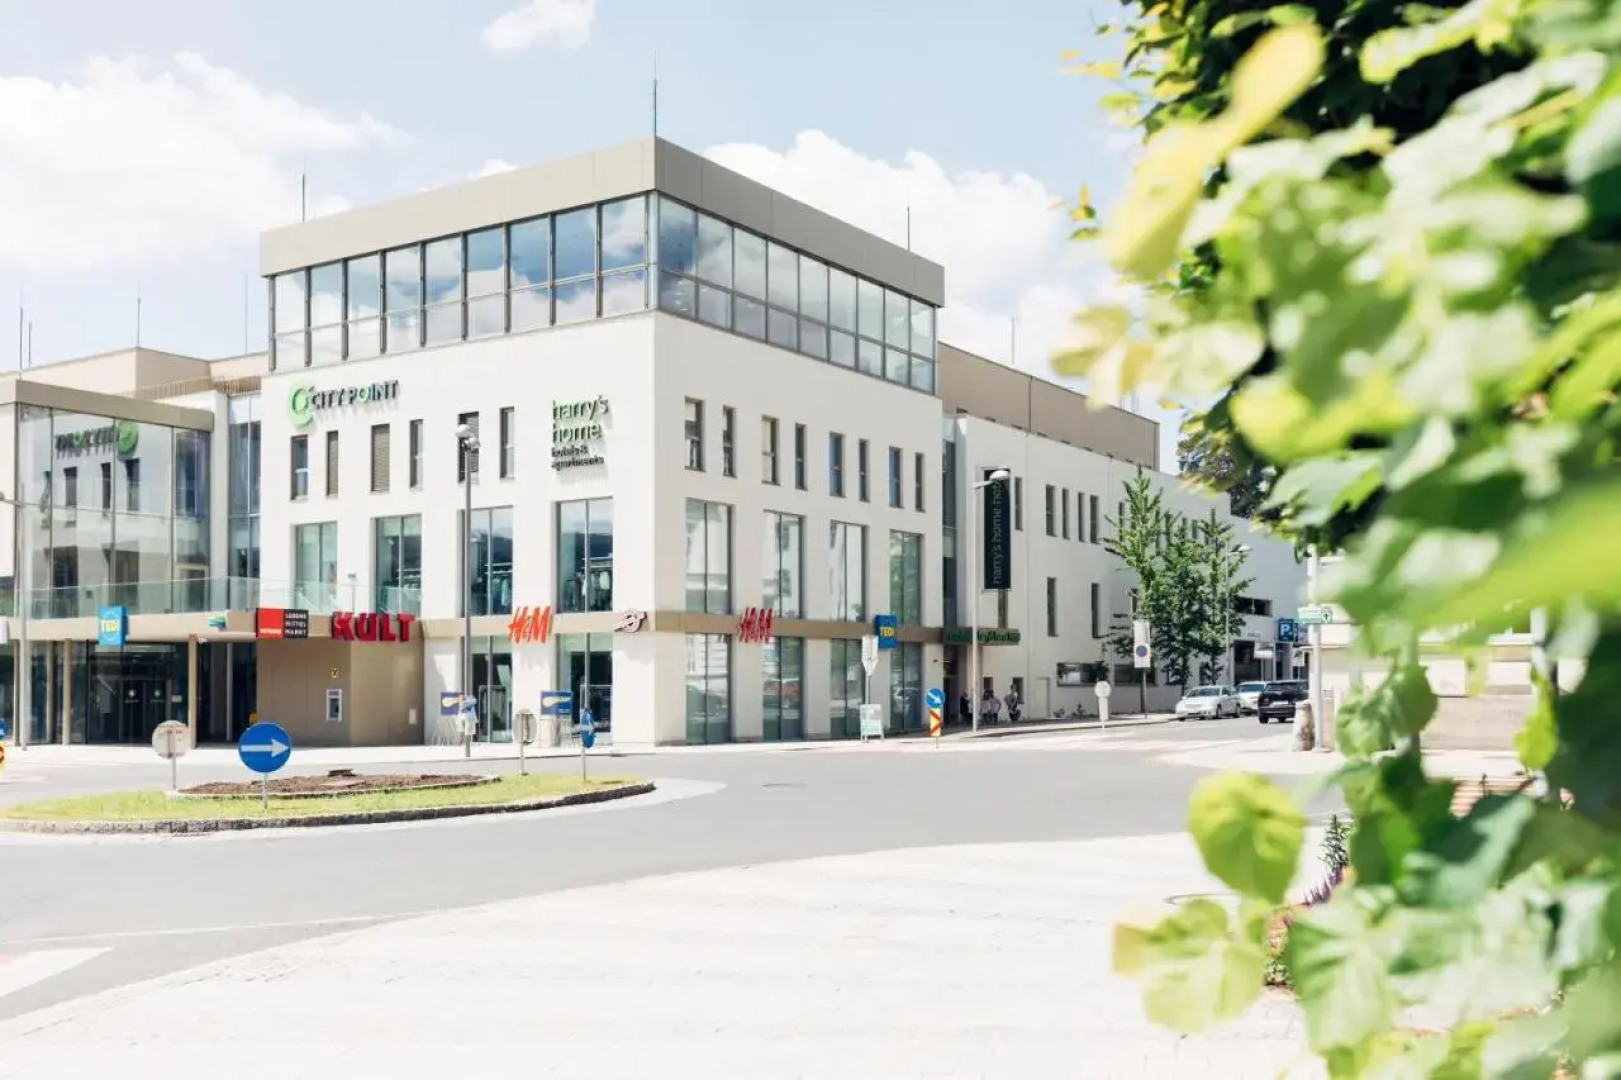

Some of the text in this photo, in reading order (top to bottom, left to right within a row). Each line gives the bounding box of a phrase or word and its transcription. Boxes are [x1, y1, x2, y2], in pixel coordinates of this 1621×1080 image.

[552, 395, 609, 420] harry's
[552, 422, 603, 443] home
[331, 611, 416, 643] KULT
[508, 605, 551, 645] H&M
[739, 605, 774, 645] H&M
